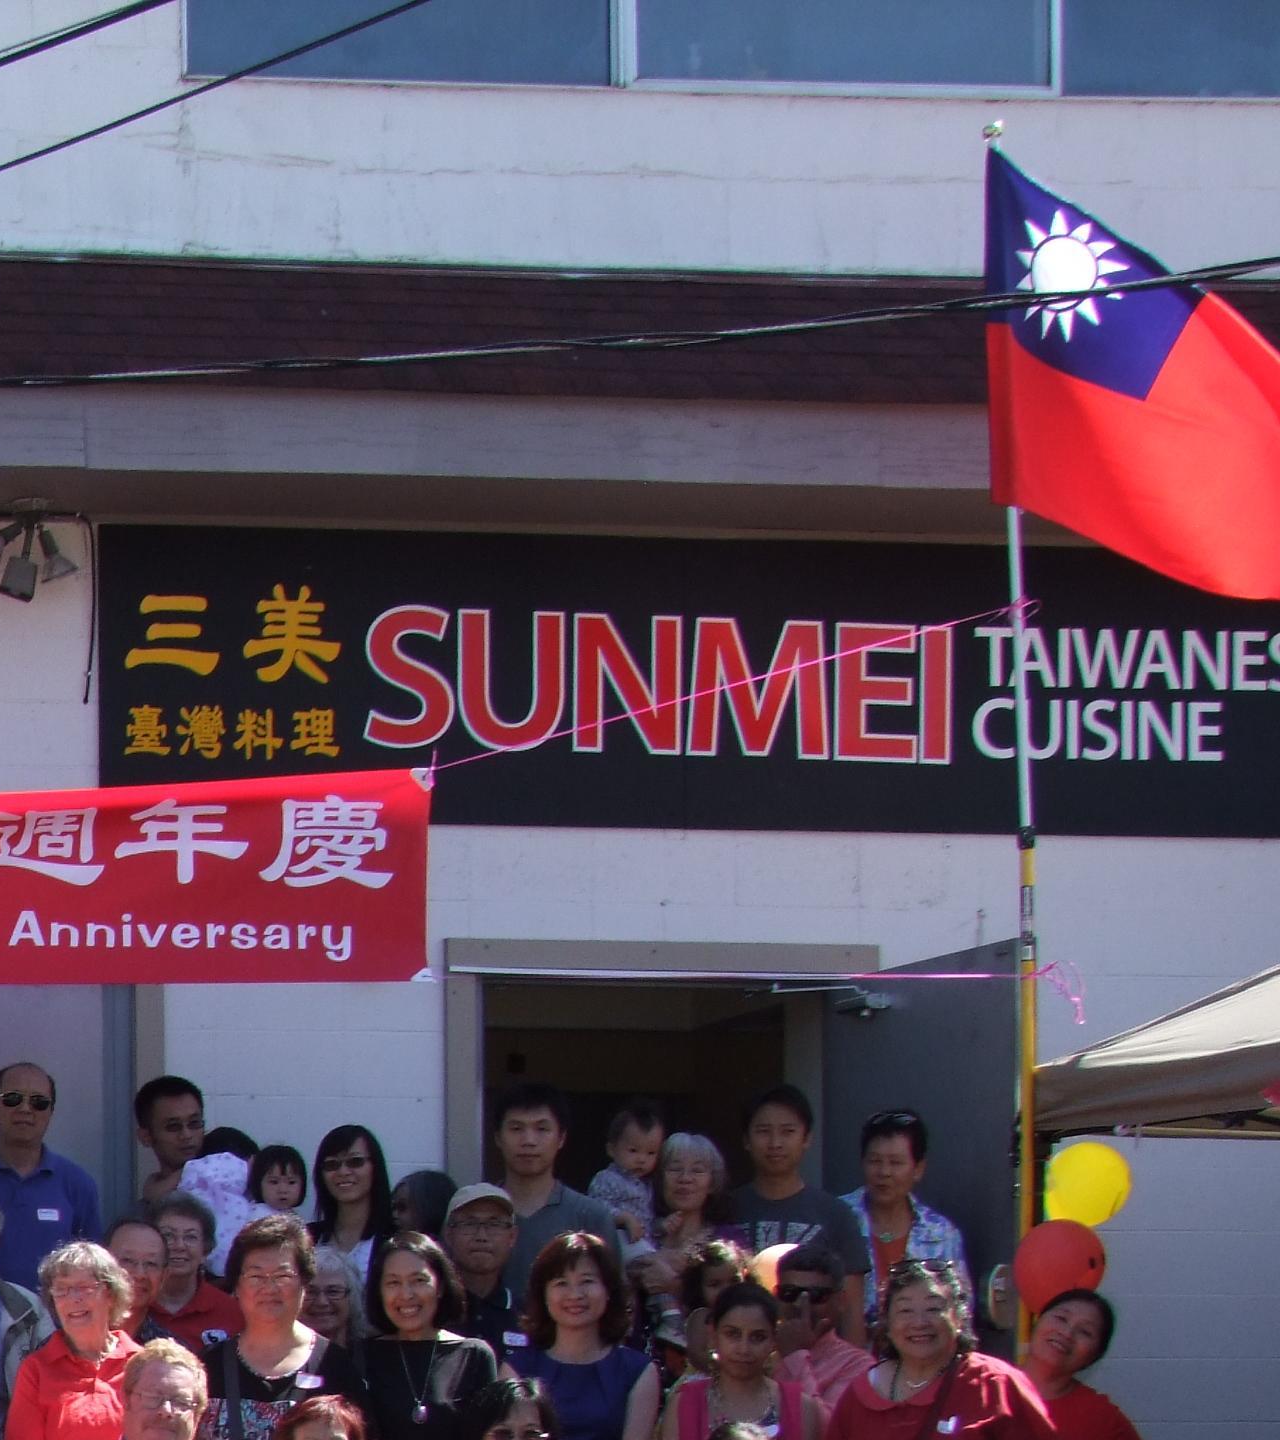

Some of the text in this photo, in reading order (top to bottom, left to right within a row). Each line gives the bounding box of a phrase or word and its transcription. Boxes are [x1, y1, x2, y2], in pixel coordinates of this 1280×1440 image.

[124, 583, 342, 684] 三美
[362, 603, 954, 765] SUNMEI
[124, 703, 342, 760] 臺灣料理
[971, 697, 1225, 762] CUISINE
[8, 910, 352, 962] Anniversary
